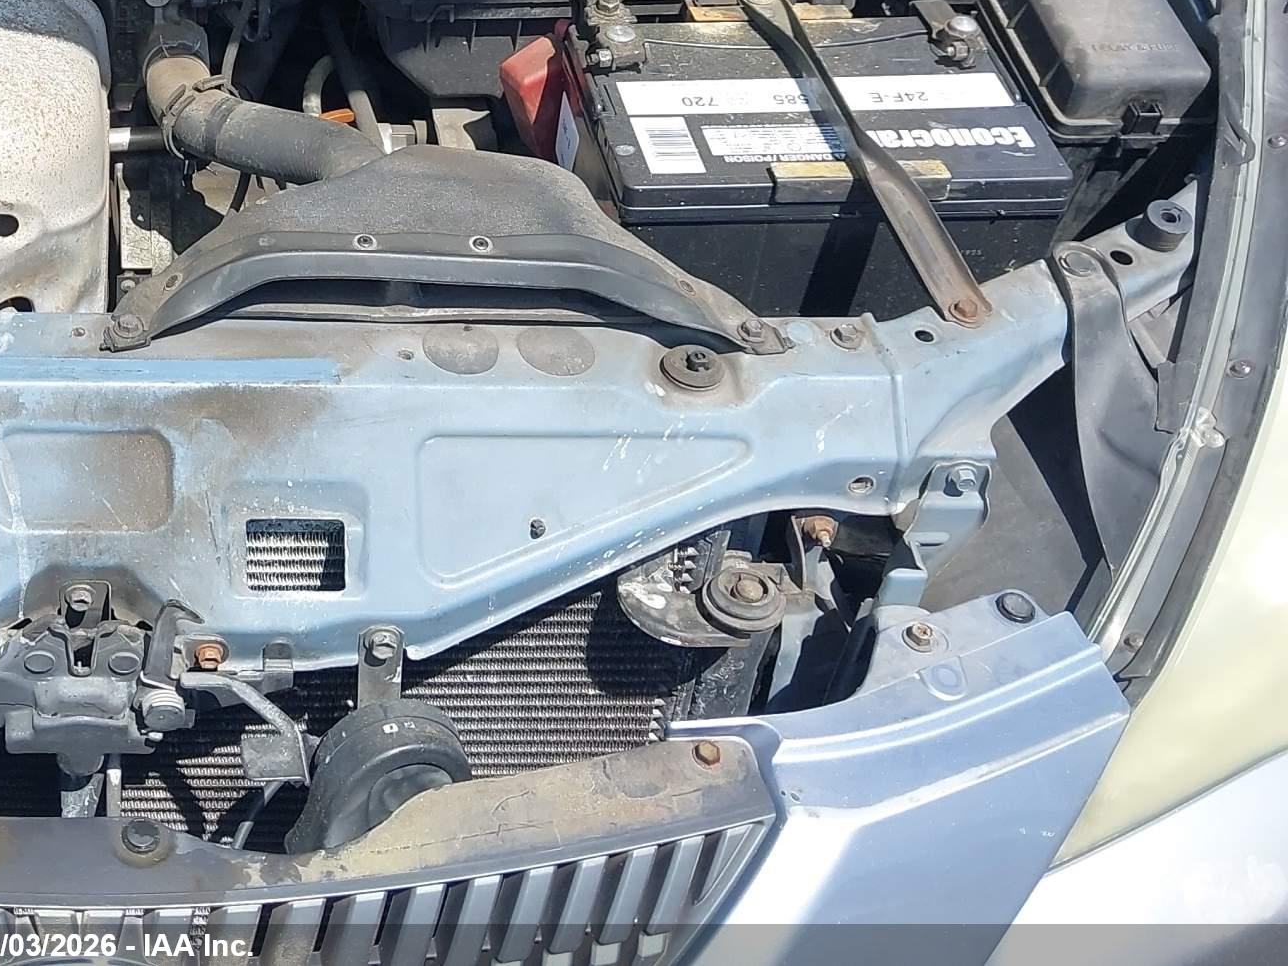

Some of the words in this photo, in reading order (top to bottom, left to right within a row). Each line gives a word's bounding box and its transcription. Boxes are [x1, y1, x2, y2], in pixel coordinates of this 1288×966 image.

[681, 96, 719, 107] 720
[773, 93, 809, 105] 585
[868, 91, 929, 103] 24F-E
